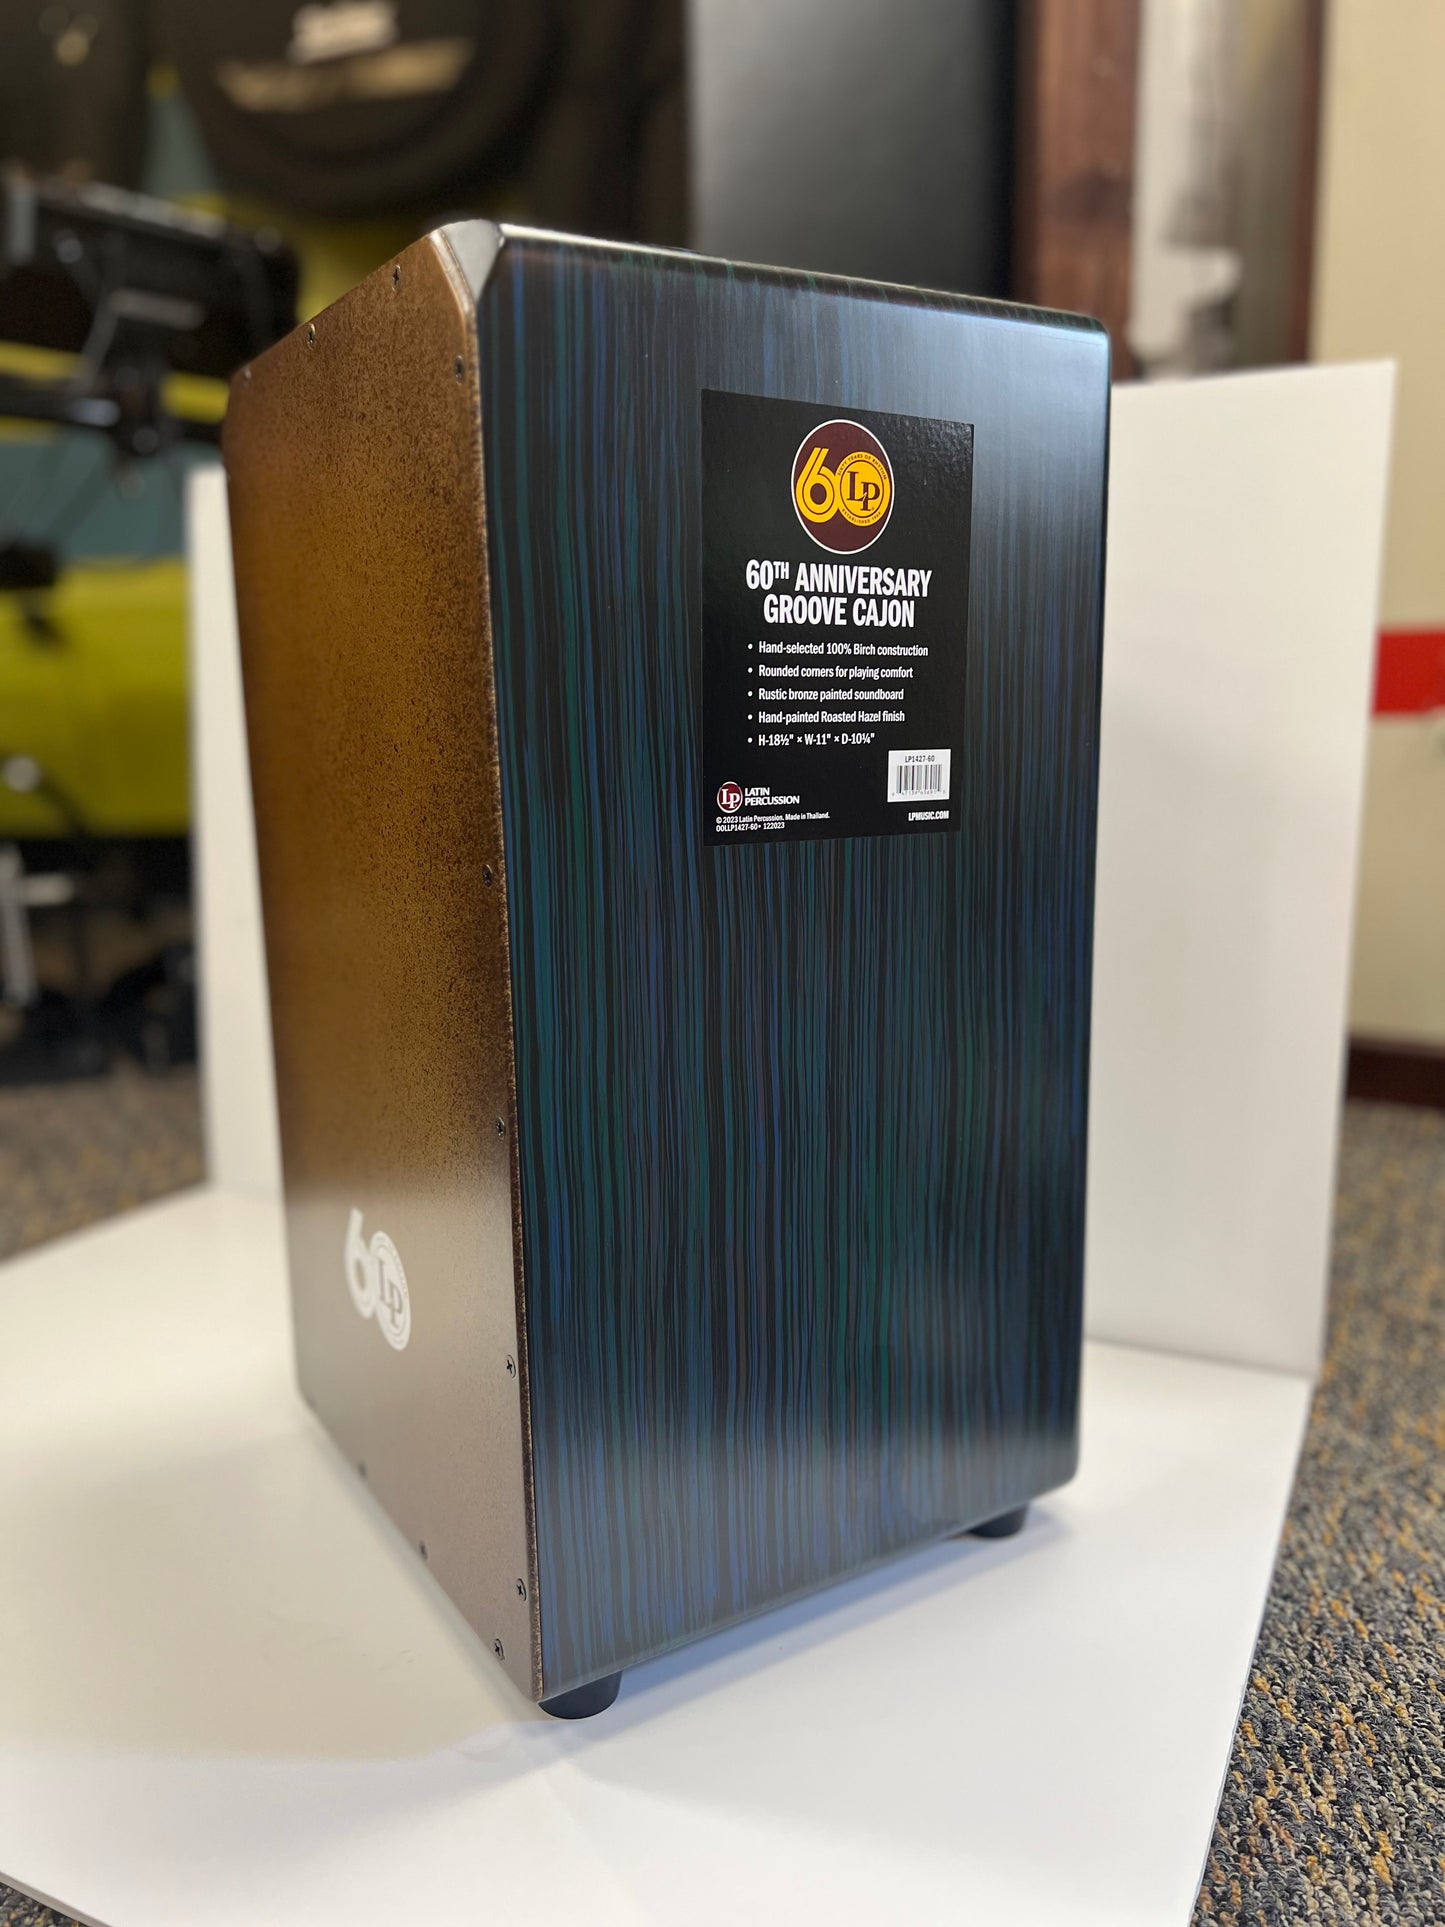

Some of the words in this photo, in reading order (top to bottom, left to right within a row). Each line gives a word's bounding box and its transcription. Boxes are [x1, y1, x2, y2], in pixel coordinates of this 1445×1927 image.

[848, 453, 863, 462] YEARS
[847, 470, 880, 511] LP
[794, 562, 932, 597] ANNIVERSARY
[763, 594, 848, 625] GROOVE
[852, 598, 915, 628] CAJON
[758, 641, 824, 654] Hand-selected
[826, 642, 851, 655] 100%
[853, 643, 876, 656] Birch
[877, 644, 929, 656] construction
[758, 664, 799, 678] Rounded
[801, 667, 834, 678] corners
[835, 665, 848, 678] for
[849, 666, 879, 680] playing
[880, 666, 914, 678] comfort
[758, 688, 787, 700] Rustic
[788, 688, 818, 700] bronze
[819, 688, 853, 702] painted
[854, 688, 904, 700] soundboard
[758, 711, 819, 725] Hand-painted
[820, 711, 857, 722] Roasted
[858, 710, 881, 722] Hazel
[882, 710, 905, 722] finish
[905, 755, 935, 763] LP1427-60
[721, 788, 740, 809] LP
[744, 787, 770, 796] LATIN
[744, 795, 800, 806] PERCUSSION
[723, 816, 738, 824] 2023
[739, 815, 753, 823] Latin
[753, 814, 784, 822] Percussion.
[785, 813, 800, 821] Made
[908, 810, 950, 821] LPMUSIC.COM
[763, 822, 785, 830] 122023
[378, 1258, 403, 1329] LP
